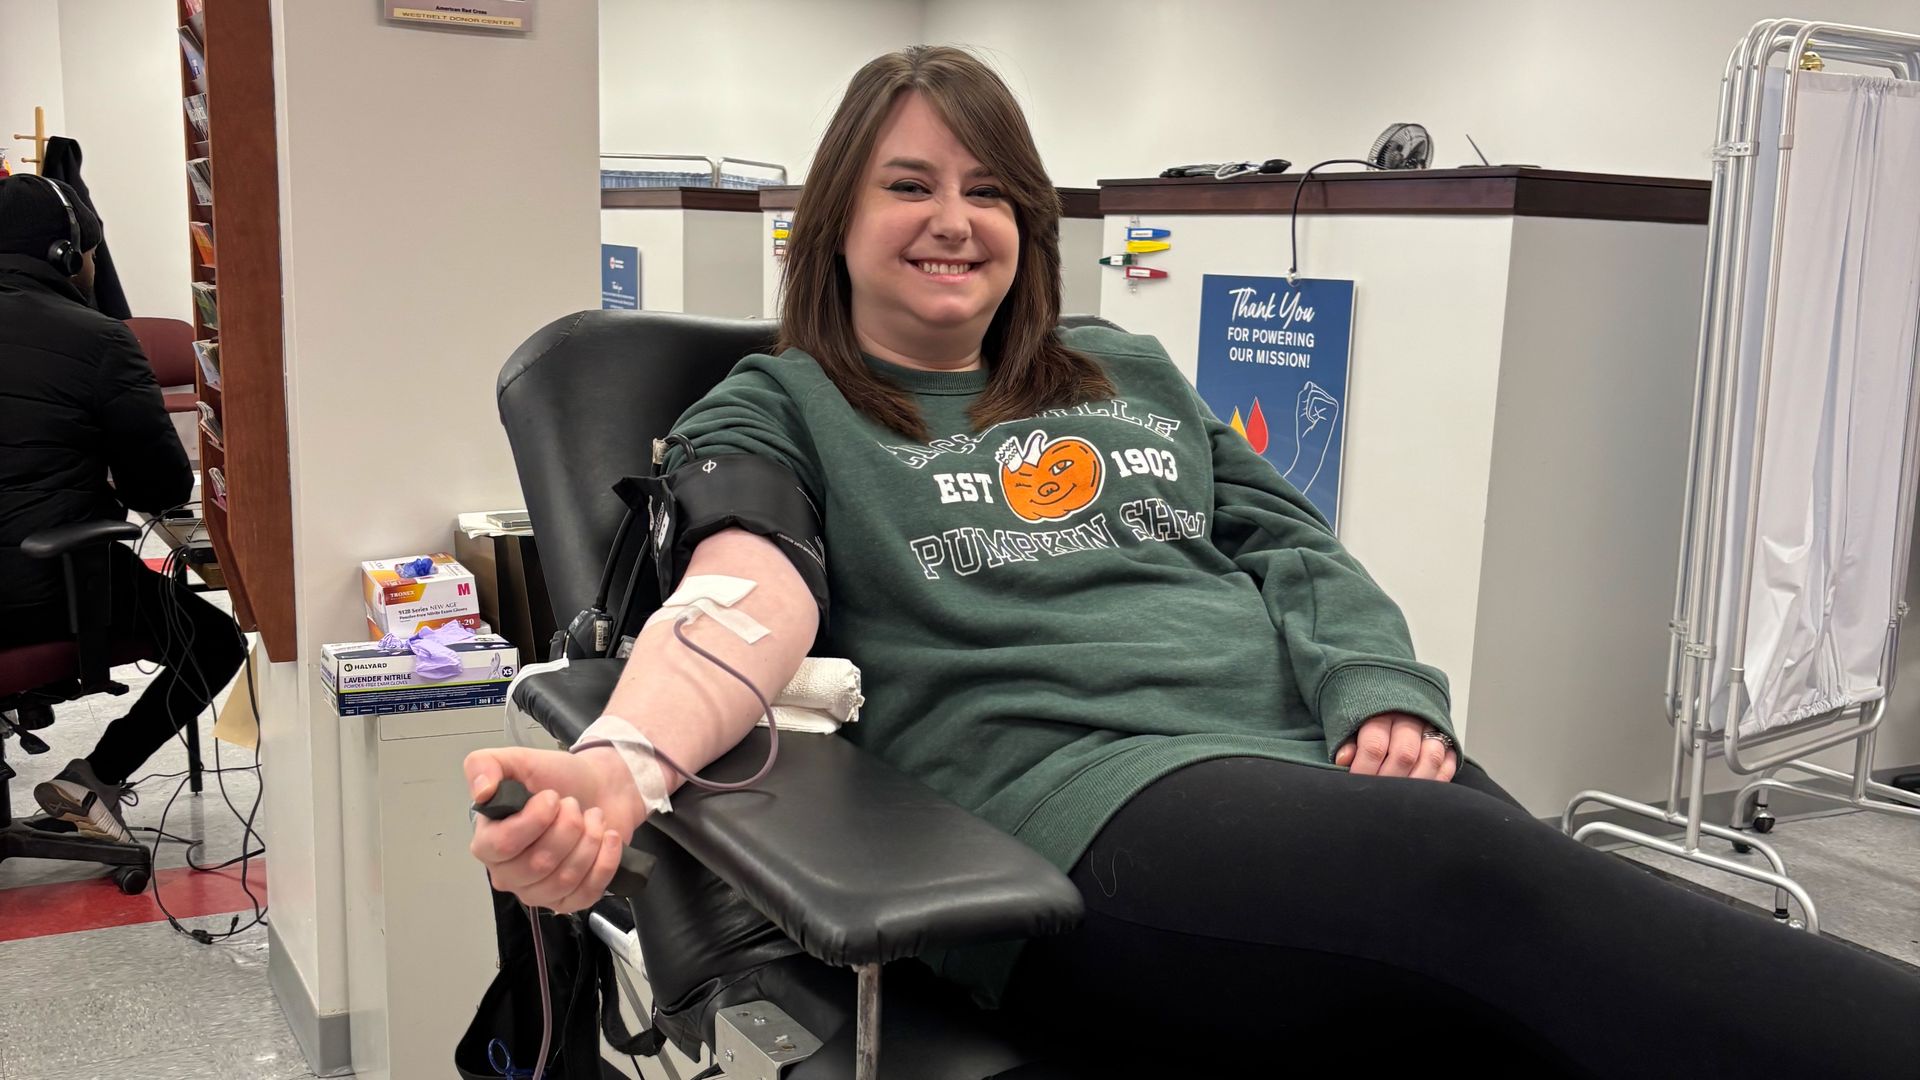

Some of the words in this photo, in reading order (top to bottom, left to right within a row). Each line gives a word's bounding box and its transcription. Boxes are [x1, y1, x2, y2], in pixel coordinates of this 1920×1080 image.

[402, 12, 447, 20] WESTBELT
[481, 18, 514, 26] CENTER
[1228, 287, 1277, 322] Thank
[1278, 291, 1316, 330] You
[1227, 326, 1249, 342] FOR
[1252, 328, 1315, 348] POWERING
[1229, 346, 1253, 363] OUR
[1256, 349, 1311, 369] MISSION!
[932, 472, 995, 504] EST
[1110, 447, 1179, 482] 1903
[909, 512, 1120, 580] PUMPKIN
[1119, 497, 1206, 542] SHW
[390, 590, 415, 598] TRONEX
[457, 582, 471, 596] M
[429, 603, 444, 611] NEW
[354, 662, 388, 670] HALYARD
[502, 668, 513, 676] XS
[343, 675, 382, 684] LAVENDER
[384, 673, 412, 681] NITRILE
